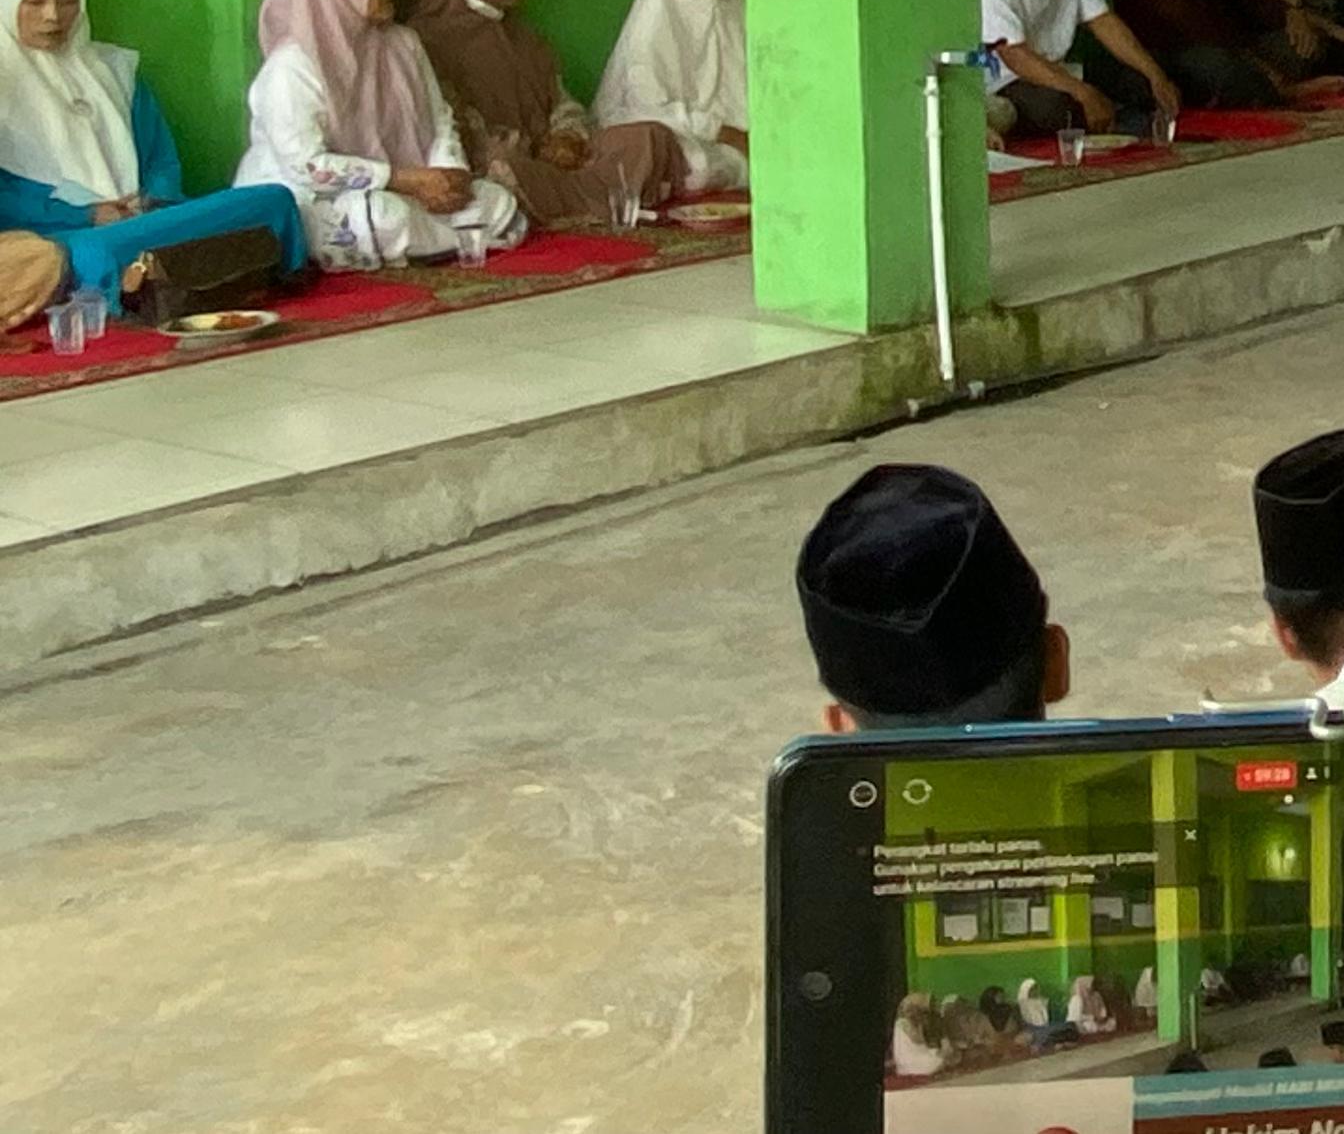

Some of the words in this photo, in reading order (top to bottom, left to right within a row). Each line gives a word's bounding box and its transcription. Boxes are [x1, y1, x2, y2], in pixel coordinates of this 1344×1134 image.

[873, 842, 947, 859] Perangkat
[949, 839, 996, 855] terlalu
[873, 861, 938, 877] Gunakan
[939, 858, 1022, 877] pengaturan
[997, 875, 1068, 890] streaming
